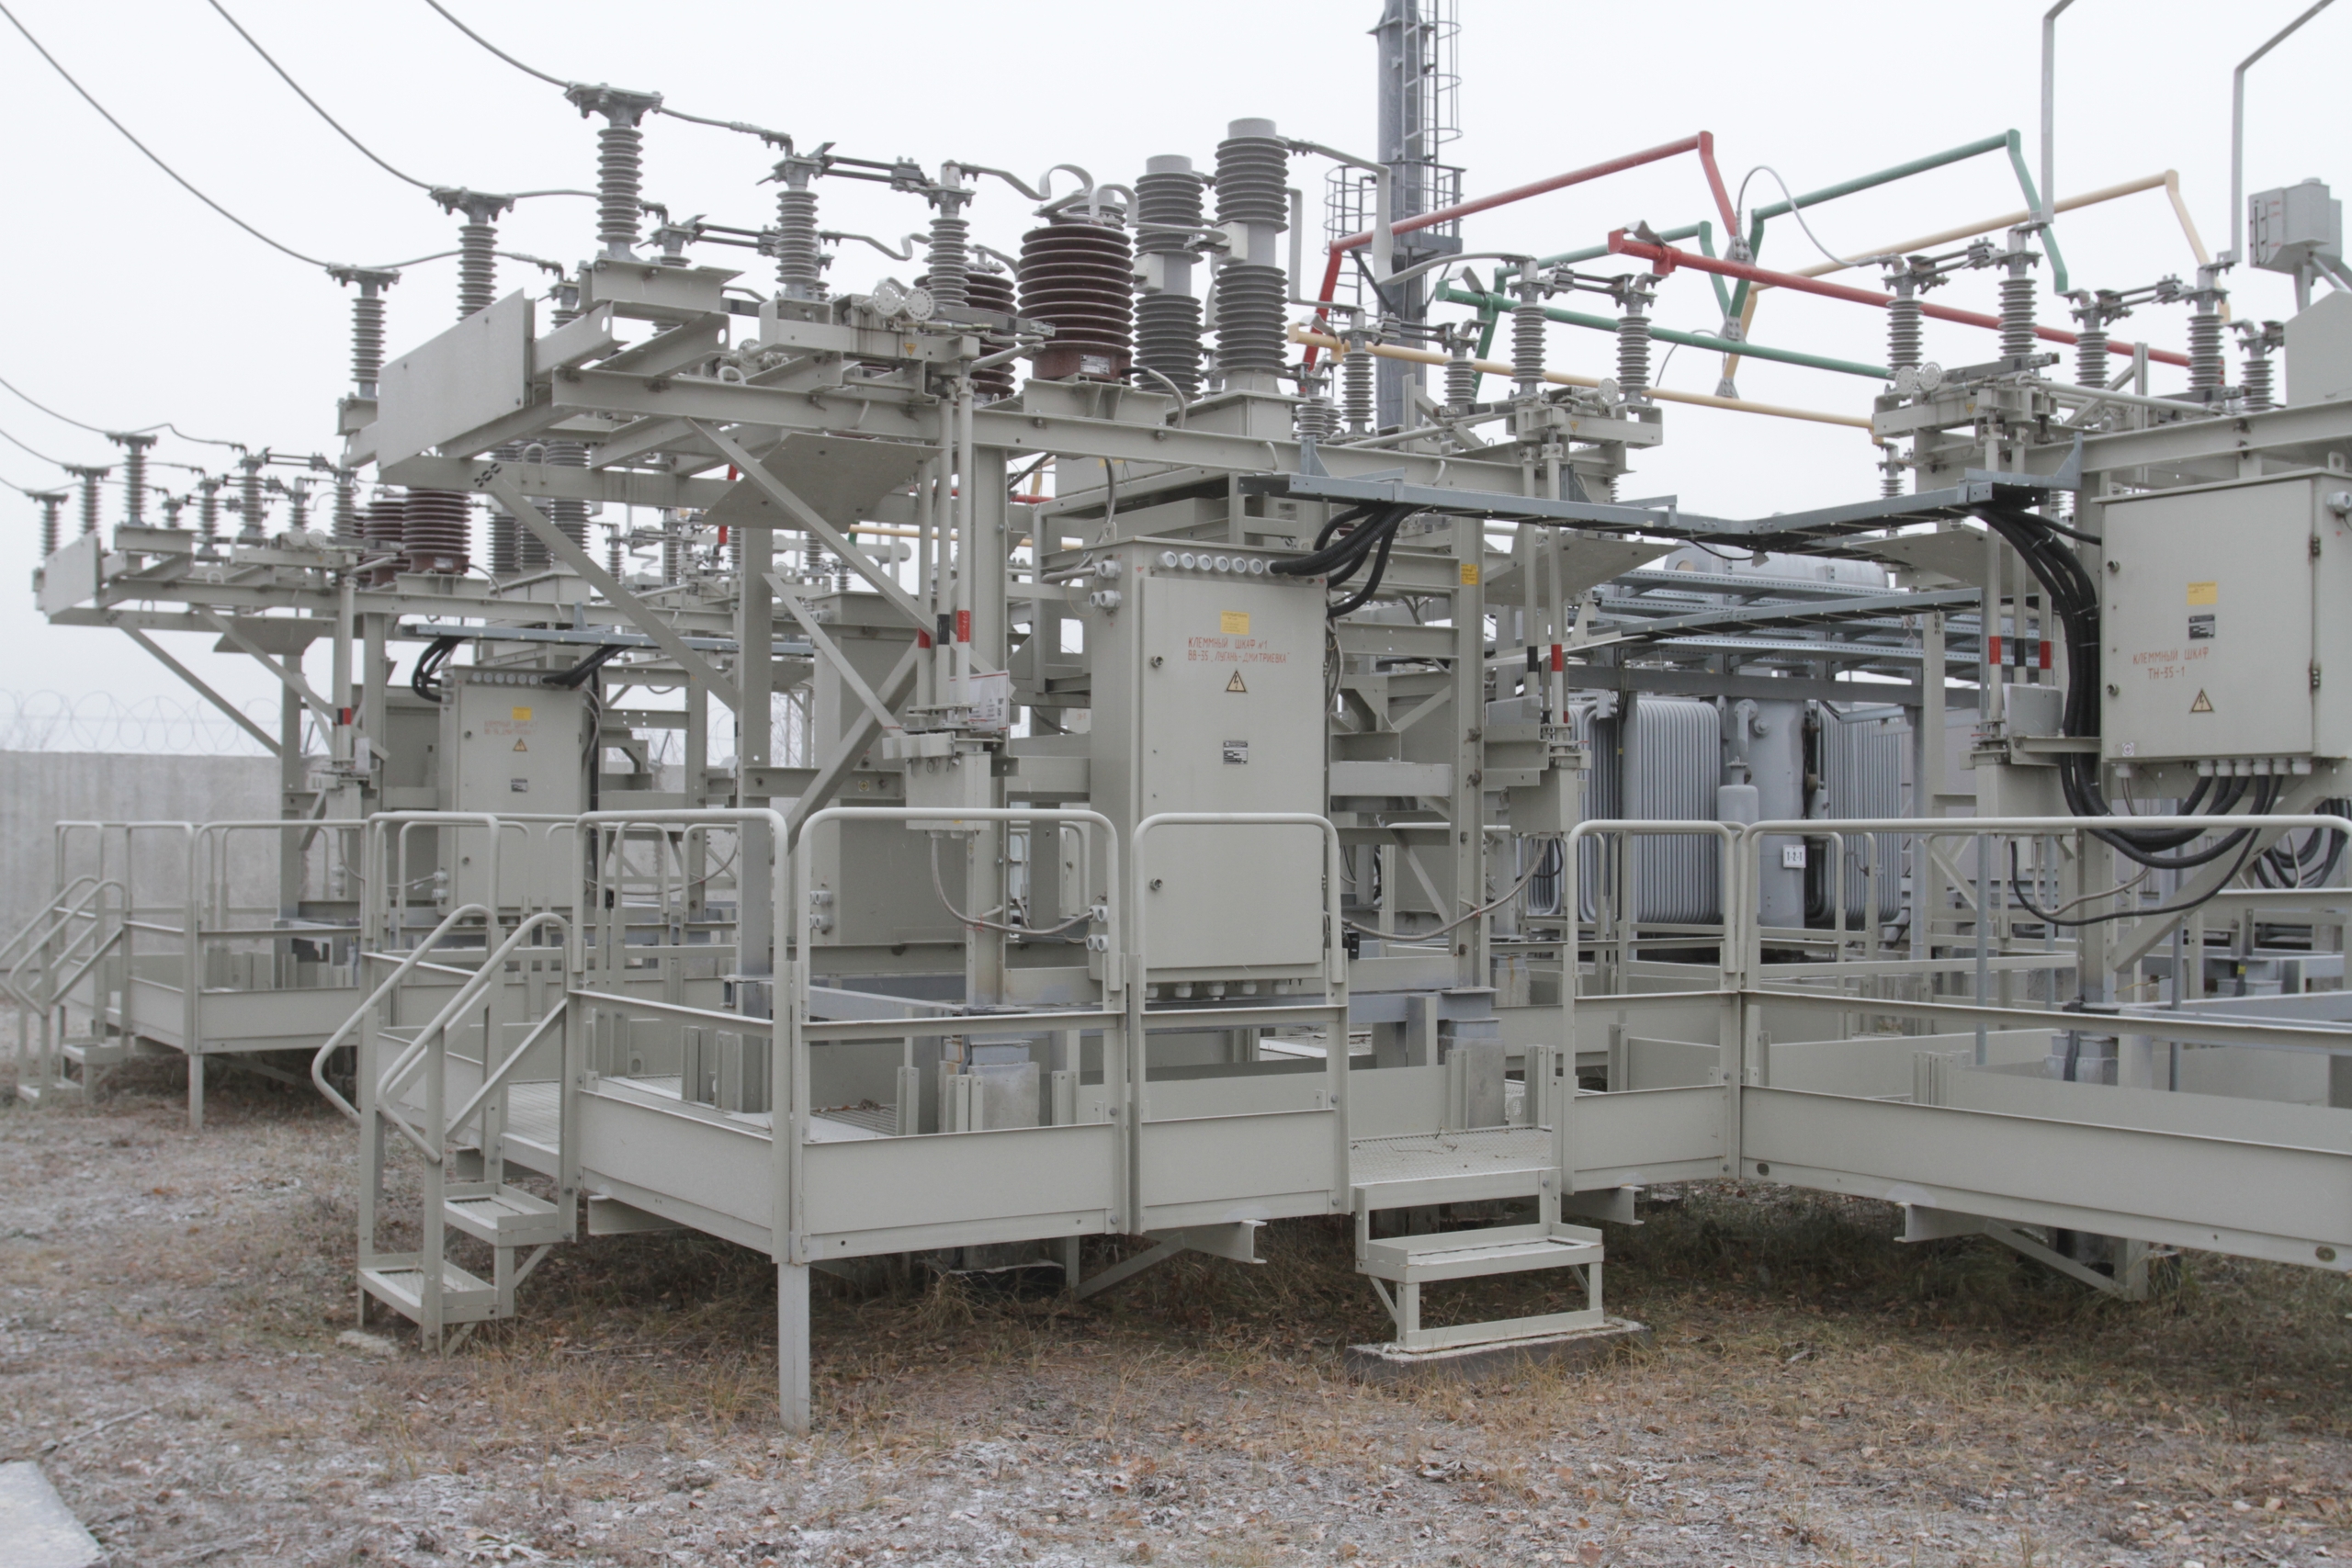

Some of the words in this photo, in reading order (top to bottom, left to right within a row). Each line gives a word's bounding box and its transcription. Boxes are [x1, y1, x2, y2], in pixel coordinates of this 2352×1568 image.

[1188, 637, 1228, 649] КЛЕММНЫЙ
[1235, 638, 1256, 649] ШКАФ
[2132, 648, 2178, 665] КЛЕММНЫЙ
[2184, 647, 2210, 660] ШКАФ
